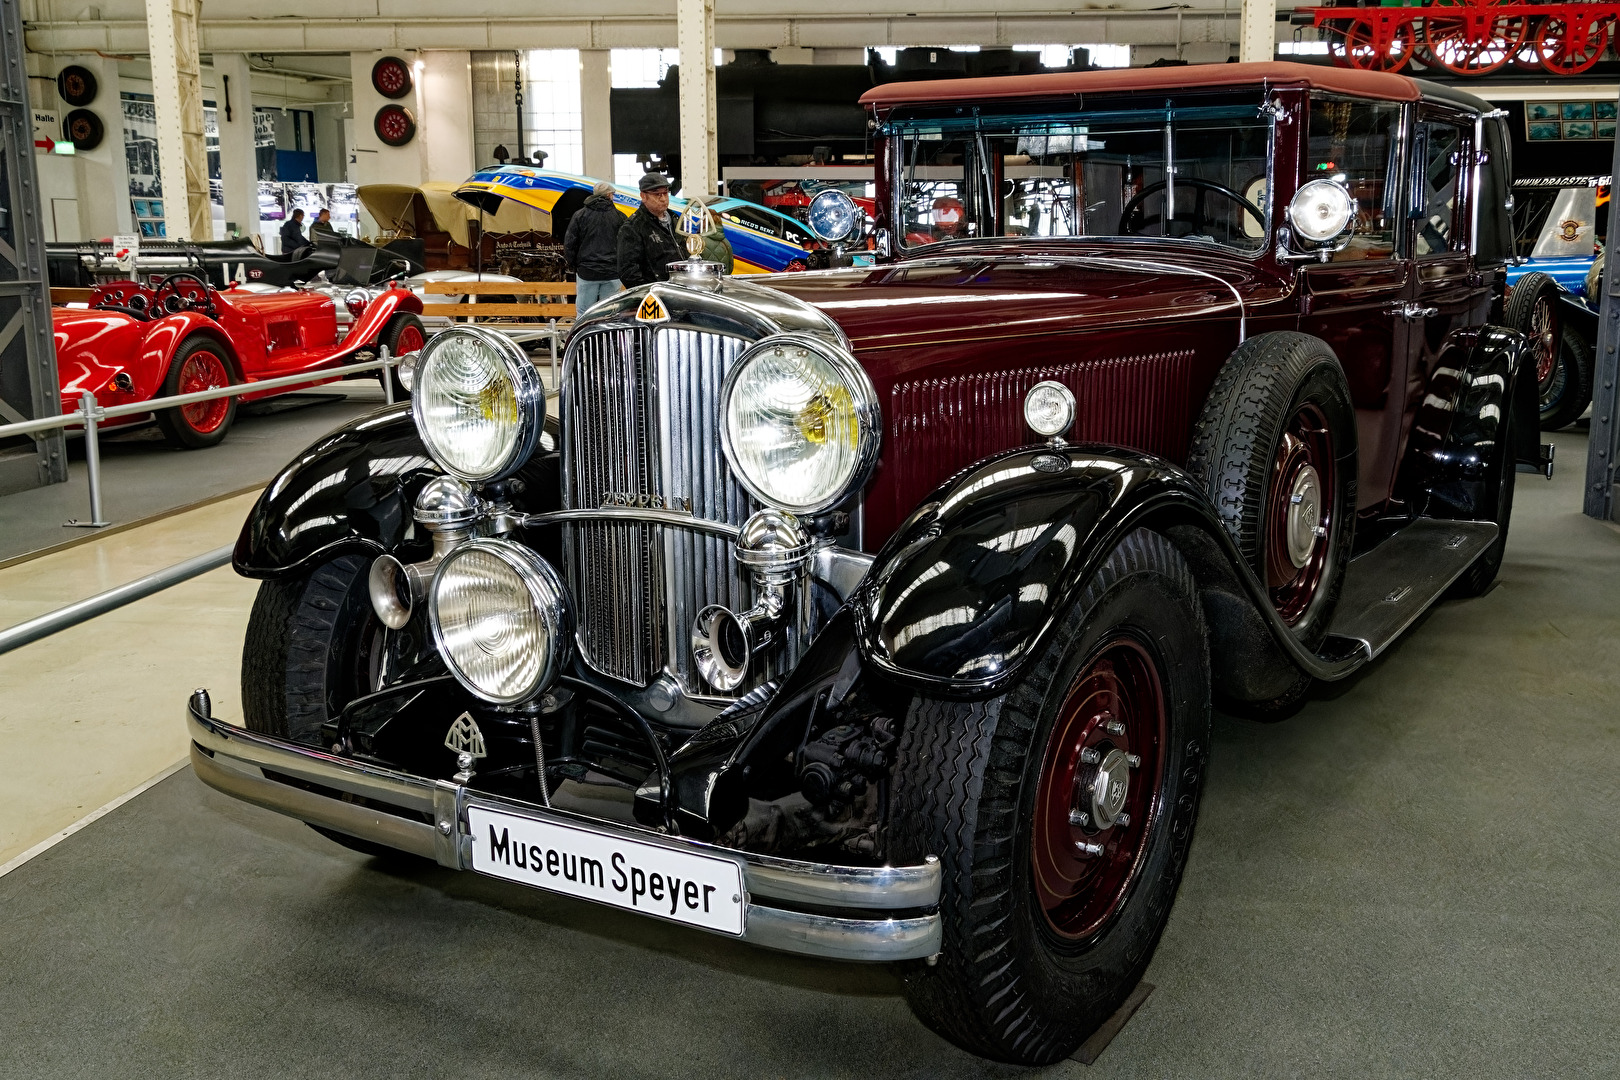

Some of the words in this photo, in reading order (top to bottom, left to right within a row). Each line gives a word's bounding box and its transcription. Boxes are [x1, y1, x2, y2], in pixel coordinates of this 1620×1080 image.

[35, 114, 55, 122] Halle
[222, 262, 247, 285] 14
[488, 824, 604, 888] Museum
[611, 852, 716, 916] Speyer
